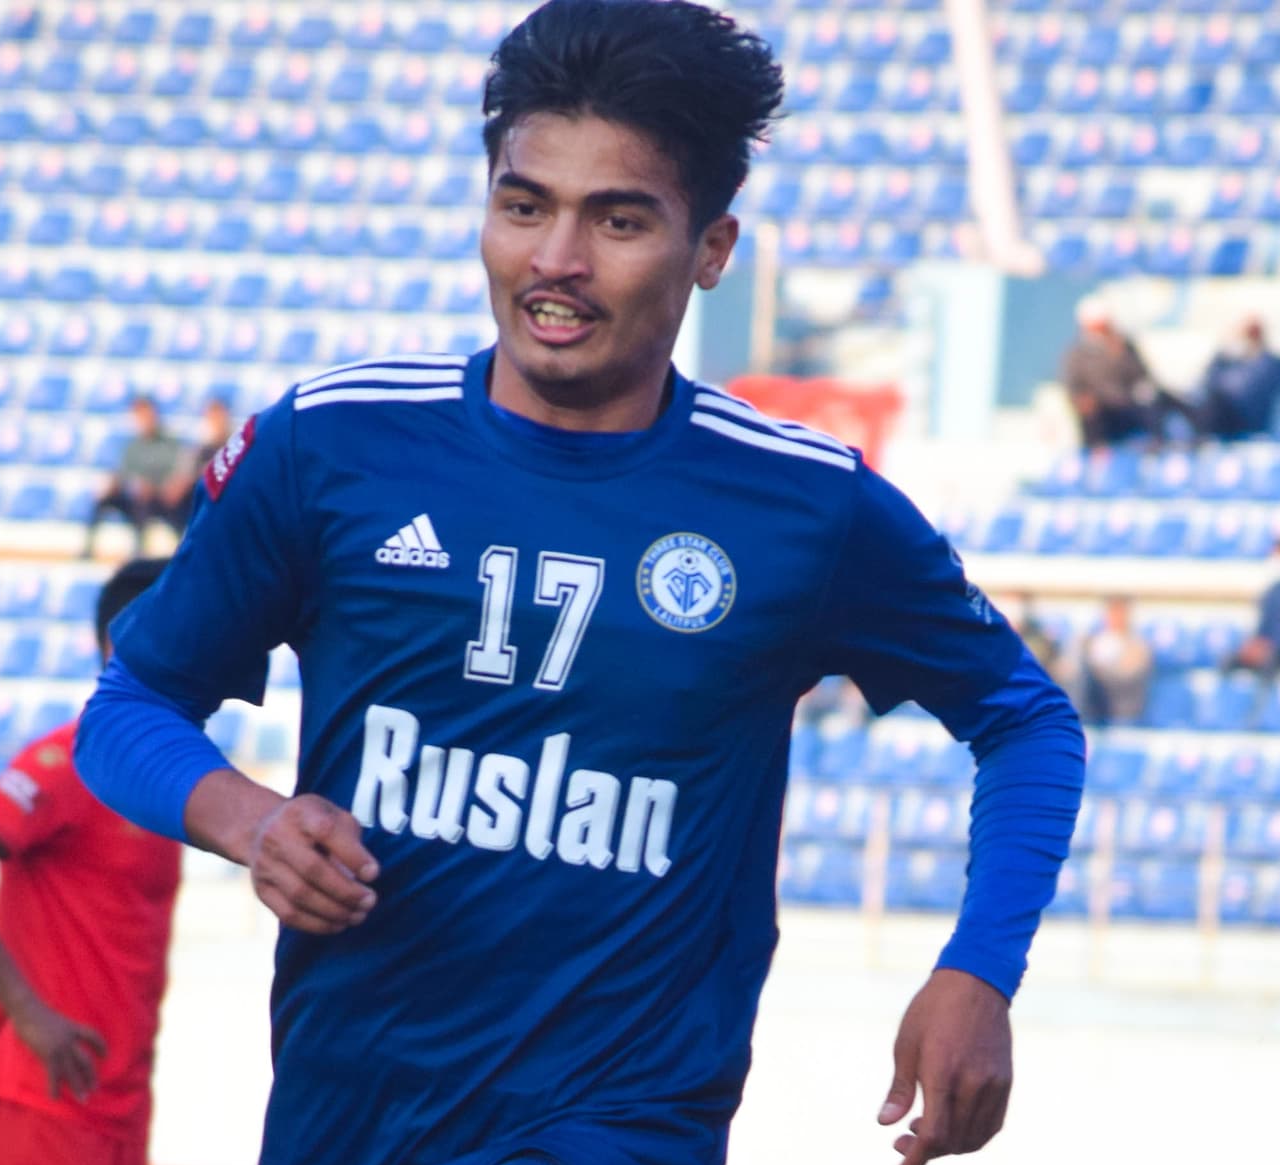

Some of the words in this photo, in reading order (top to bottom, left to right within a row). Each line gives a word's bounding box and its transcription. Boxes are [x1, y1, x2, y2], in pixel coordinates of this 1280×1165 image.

[374, 547, 450, 569] adidas
[463, 544, 606, 691] 17
[351, 703, 679, 878] Ruslan
